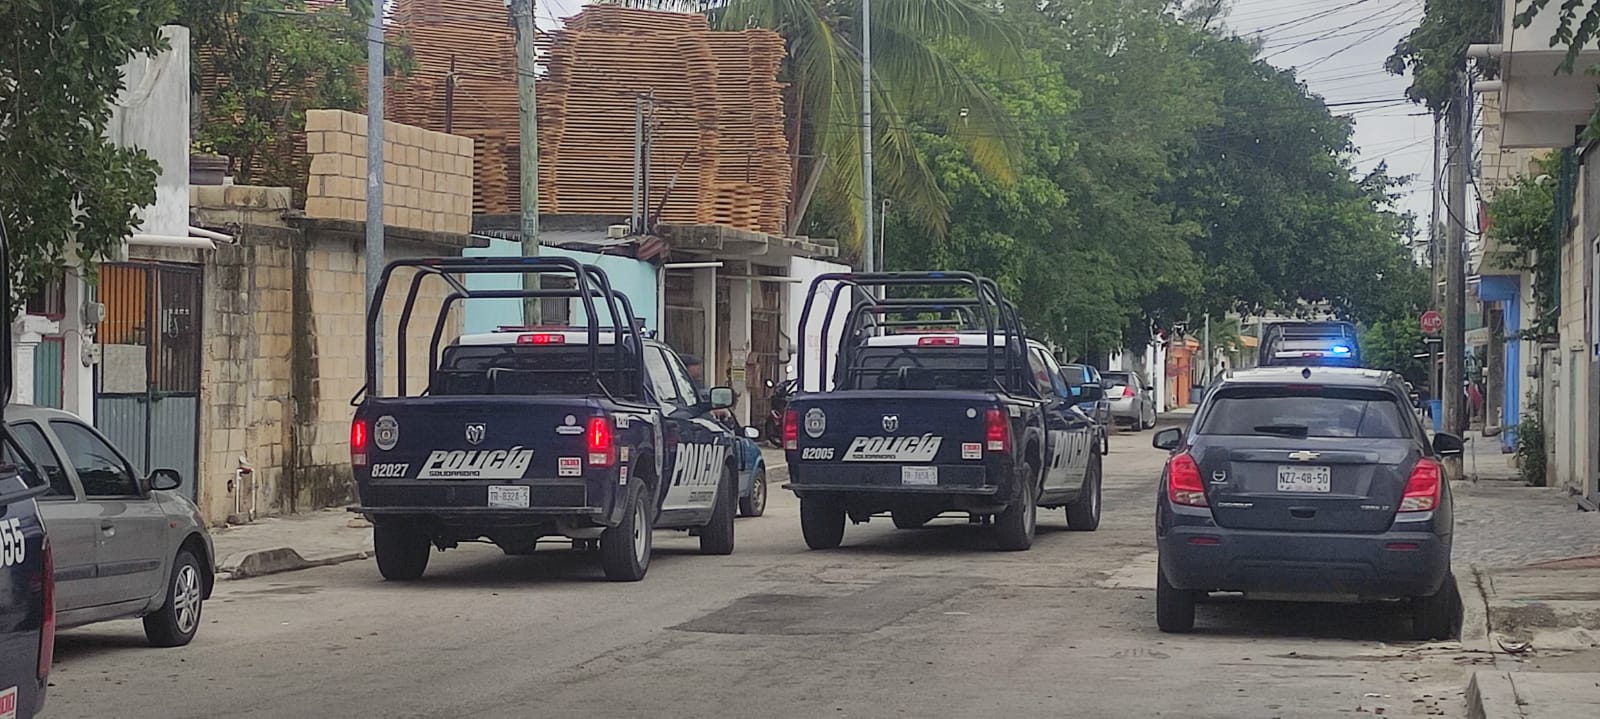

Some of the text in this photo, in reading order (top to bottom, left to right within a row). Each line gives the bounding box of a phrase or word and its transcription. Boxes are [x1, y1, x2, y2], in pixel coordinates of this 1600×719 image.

[802, 447, 835, 460] 82005
[845, 433, 943, 456] POLICÍA
[371, 463, 409, 478] 82027
[424, 446, 534, 472] POLICÍA
[671, 437, 724, 486] POLICÍA
